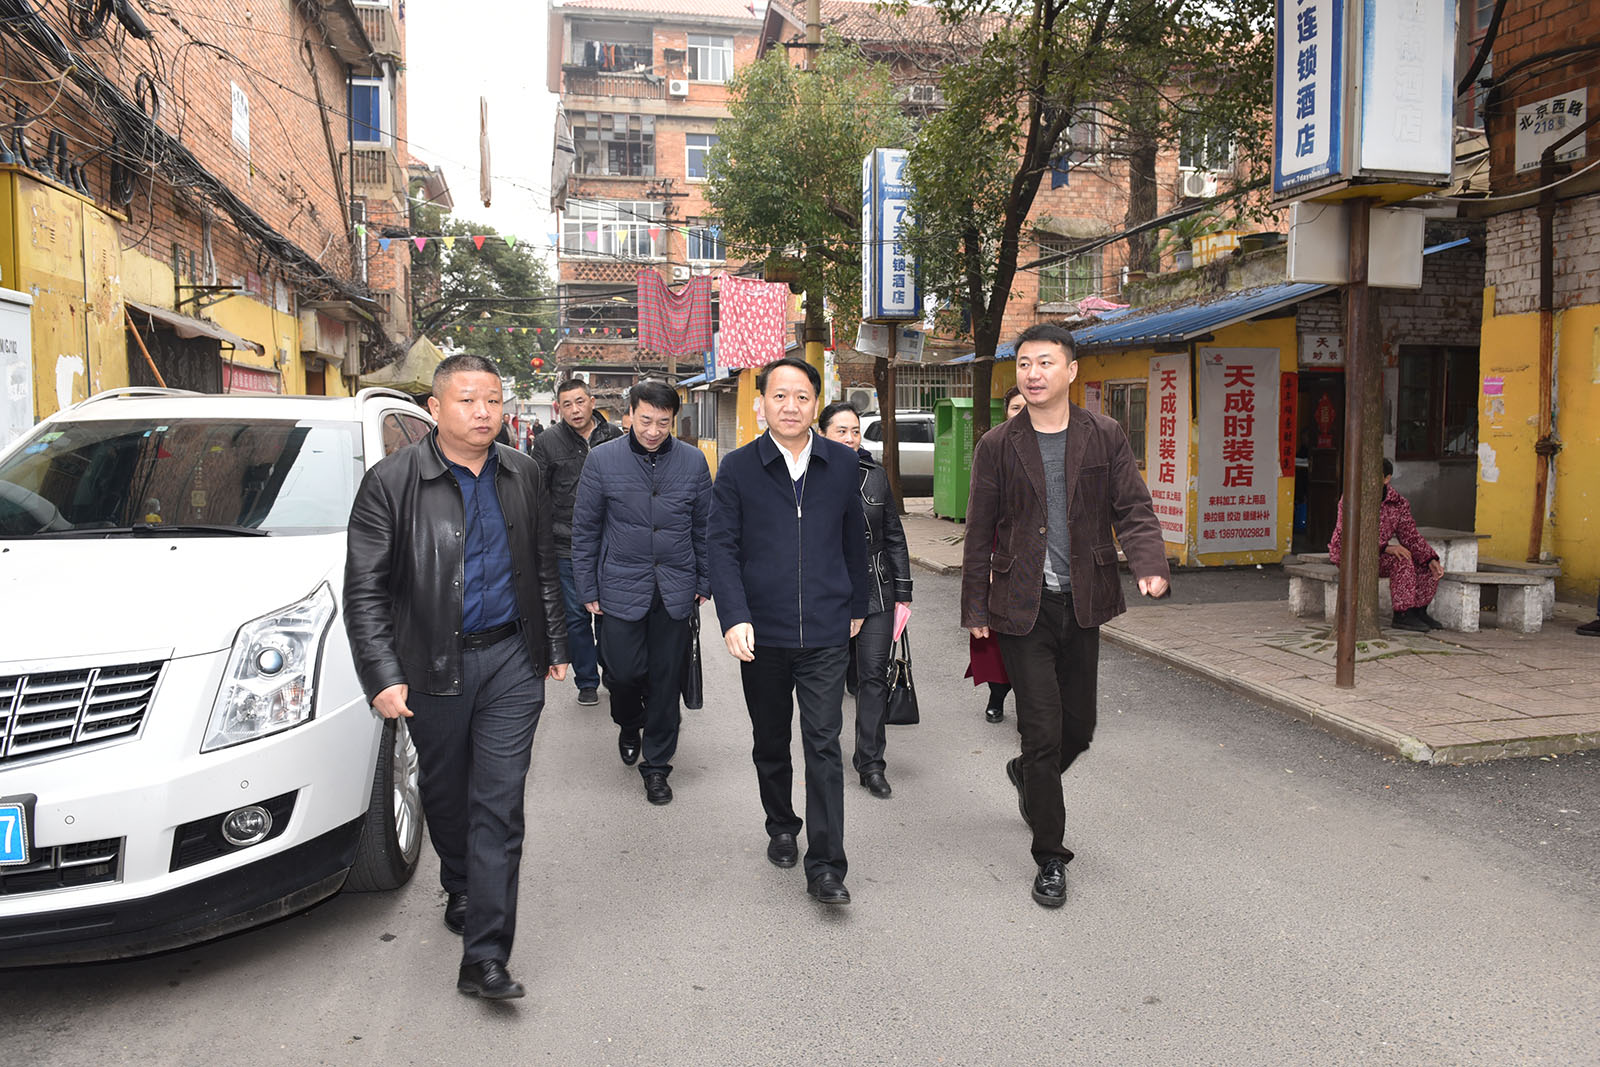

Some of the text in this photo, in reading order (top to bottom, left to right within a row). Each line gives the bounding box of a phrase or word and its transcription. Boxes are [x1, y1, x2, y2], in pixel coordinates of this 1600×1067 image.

[1296, 0, 1319, 158] 连锁酒店
[1519, 98, 1584, 131] 北京西路
[1159, 369, 1177, 484] 天成时装店
[1223, 364, 1256, 488] 天成时装店
[1238, 494, 1266, 505] 床上用品
